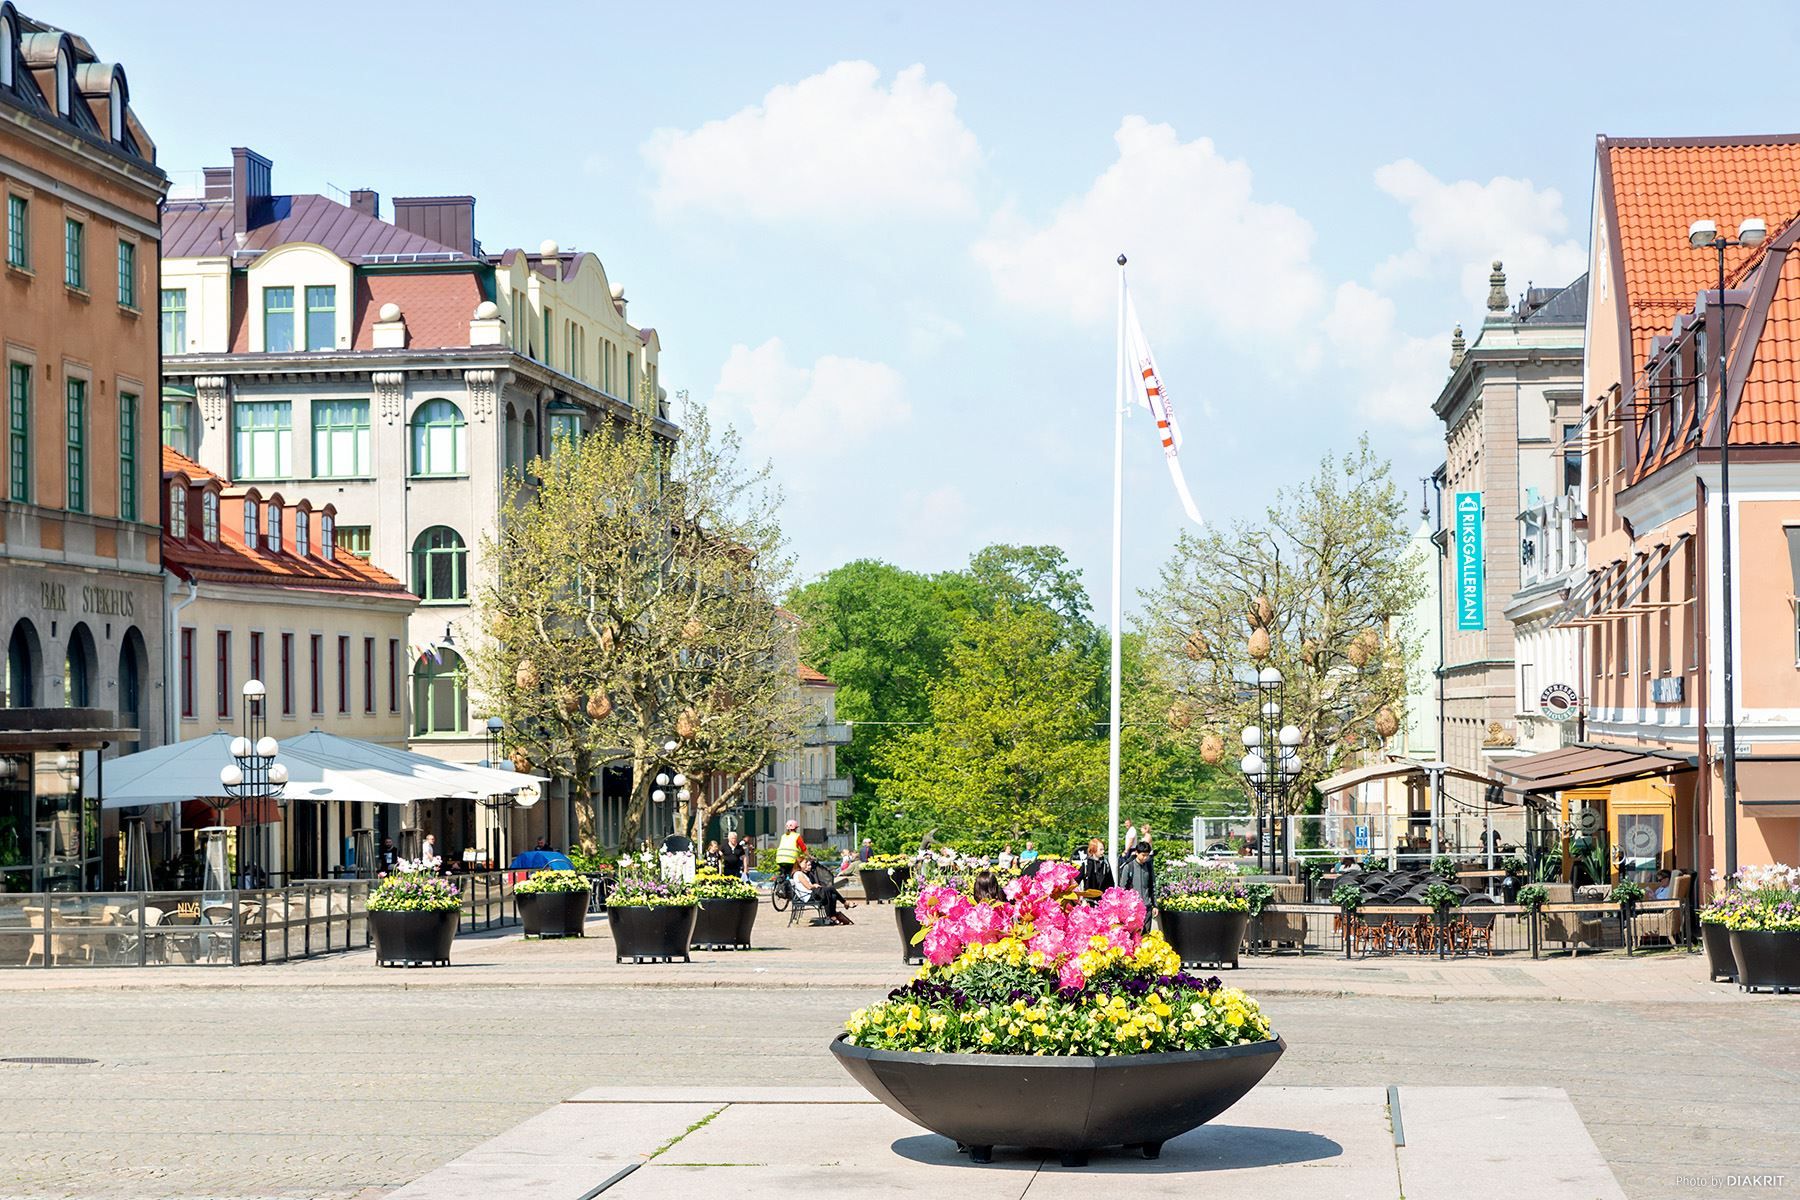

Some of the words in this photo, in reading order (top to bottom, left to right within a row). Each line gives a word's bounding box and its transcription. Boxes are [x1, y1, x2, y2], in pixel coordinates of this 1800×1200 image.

[1462, 514, 1477, 620] RIKSGALLERIAN
[40, 581, 66, 612] BAR
[1541, 684, 1577, 701] ESPRESSO
[1546, 709, 1572, 721] HOUSE
